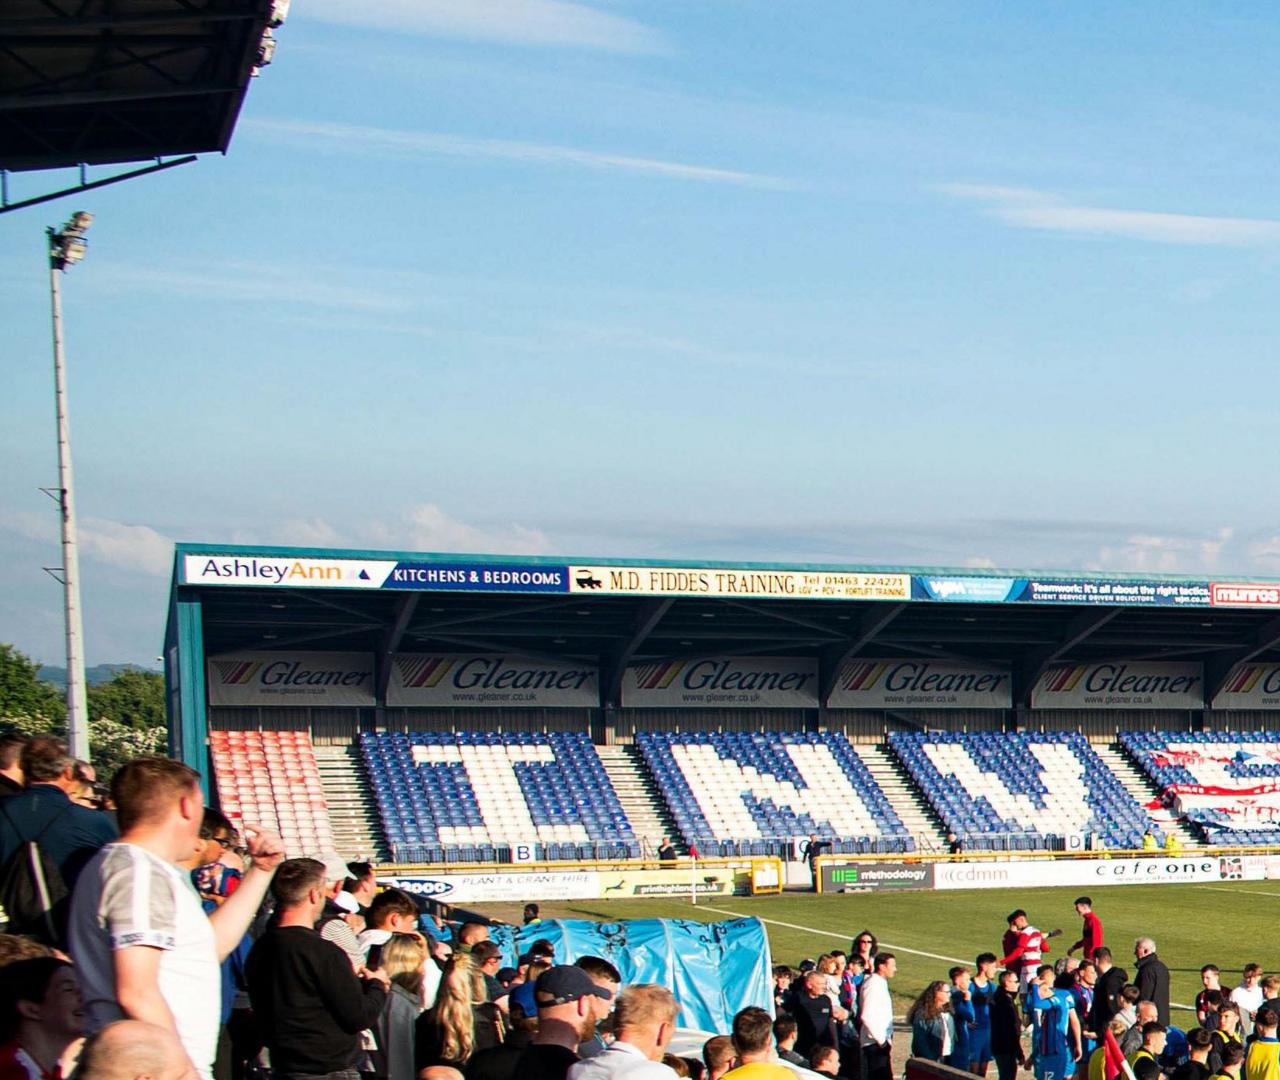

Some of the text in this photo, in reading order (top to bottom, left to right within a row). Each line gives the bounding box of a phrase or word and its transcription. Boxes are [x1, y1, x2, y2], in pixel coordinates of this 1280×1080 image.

[202, 559, 341, 583] AshleyAnn
[394, 569, 561, 585] KITCHENS & BEDROOMS
[610, 571, 795, 594] M.D. FIDDES TRAINING
[804, 575, 903, 587] Tel 01463 224271
[1100, 584, 1110, 594] all
[1113, 584, 1138, 595] about
[1140, 585, 1156, 595] the
[1157, 585, 1177, 597] right
[1217, 587, 1279, 603] munros
[261, 661, 372, 686] Gleaner
[453, 658, 596, 691] Gleaner
[683, 660, 816, 691] Gleaner
[885, 661, 1008, 692] Gleaner
[1085, 664, 1201, 694] Gleaner
[452, 692, 537, 703] www.gleaner.co.uk
[682, 693, 760, 703] www.gleaner.co.uk
[884, 694, 958, 704] www.gleaner.co.uk
[1084, 696, 1152, 705] www.gleaner.co.uk
[1070, 835, 1080, 849] D
[518, 846, 530, 861] B
[1096, 861, 1213, 876] cafe one
[462, 875, 589, 885] PLANT & CRANE HIRE
